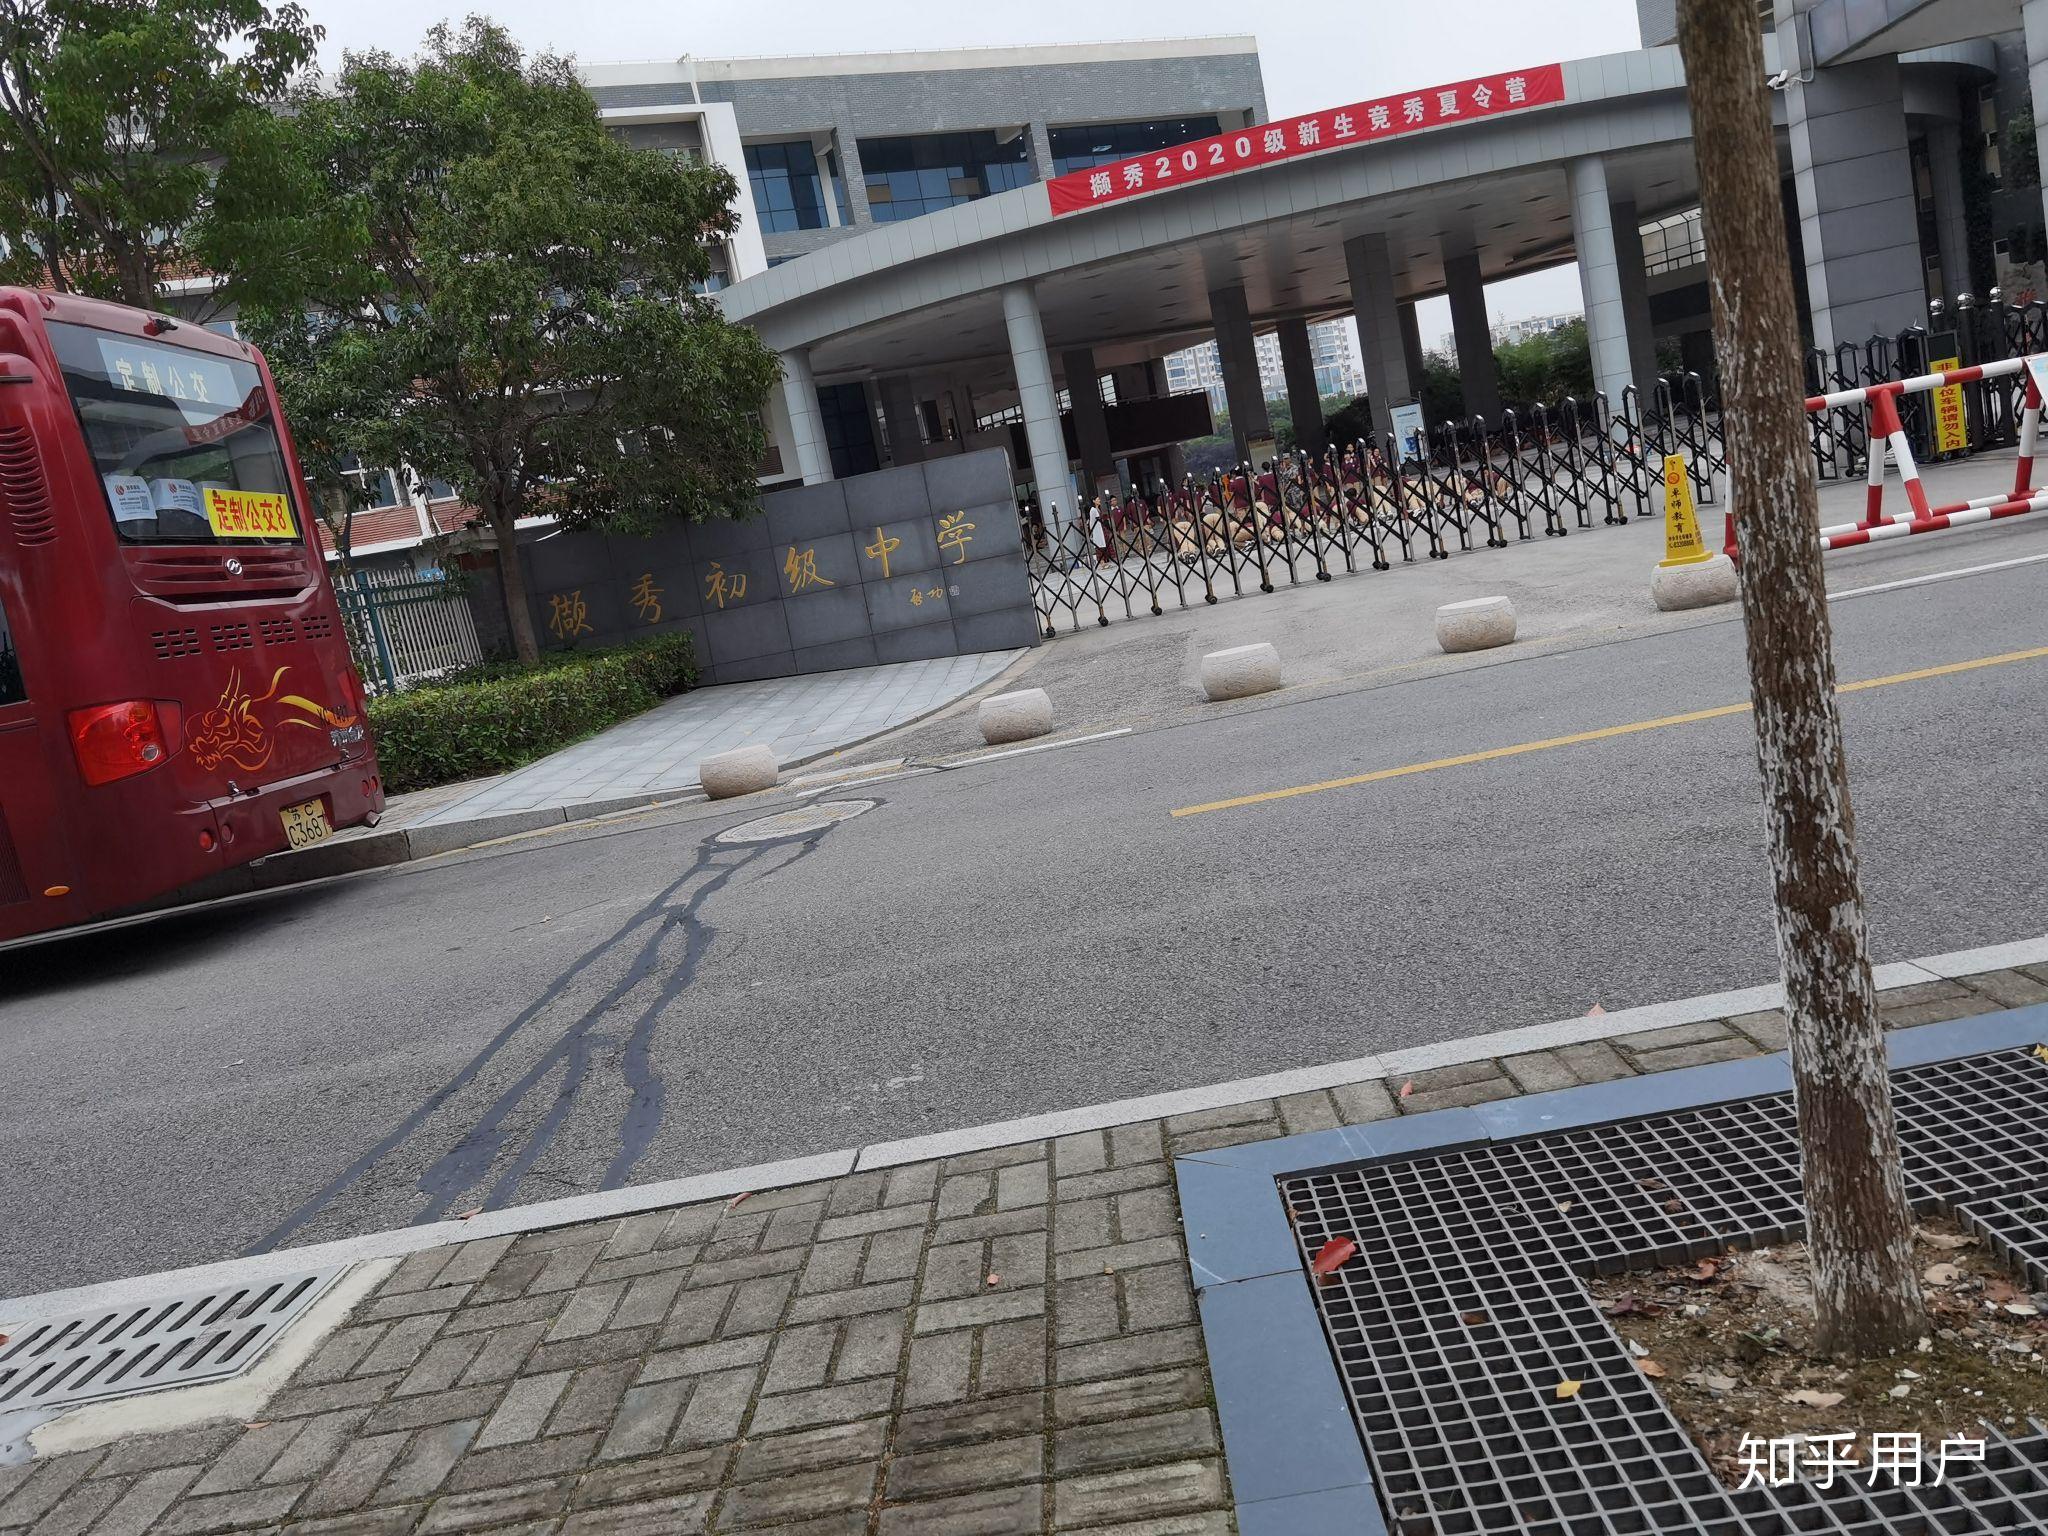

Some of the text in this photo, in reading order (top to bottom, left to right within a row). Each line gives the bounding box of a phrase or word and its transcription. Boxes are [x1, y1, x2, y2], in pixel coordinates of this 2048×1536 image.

[1090, 77, 1527, 198] 撷秀2020级新生竞秀夏令营
[115, 357, 211, 403] 定制公交
[1936, 363, 1960, 448] 非位车辆请勿入内
